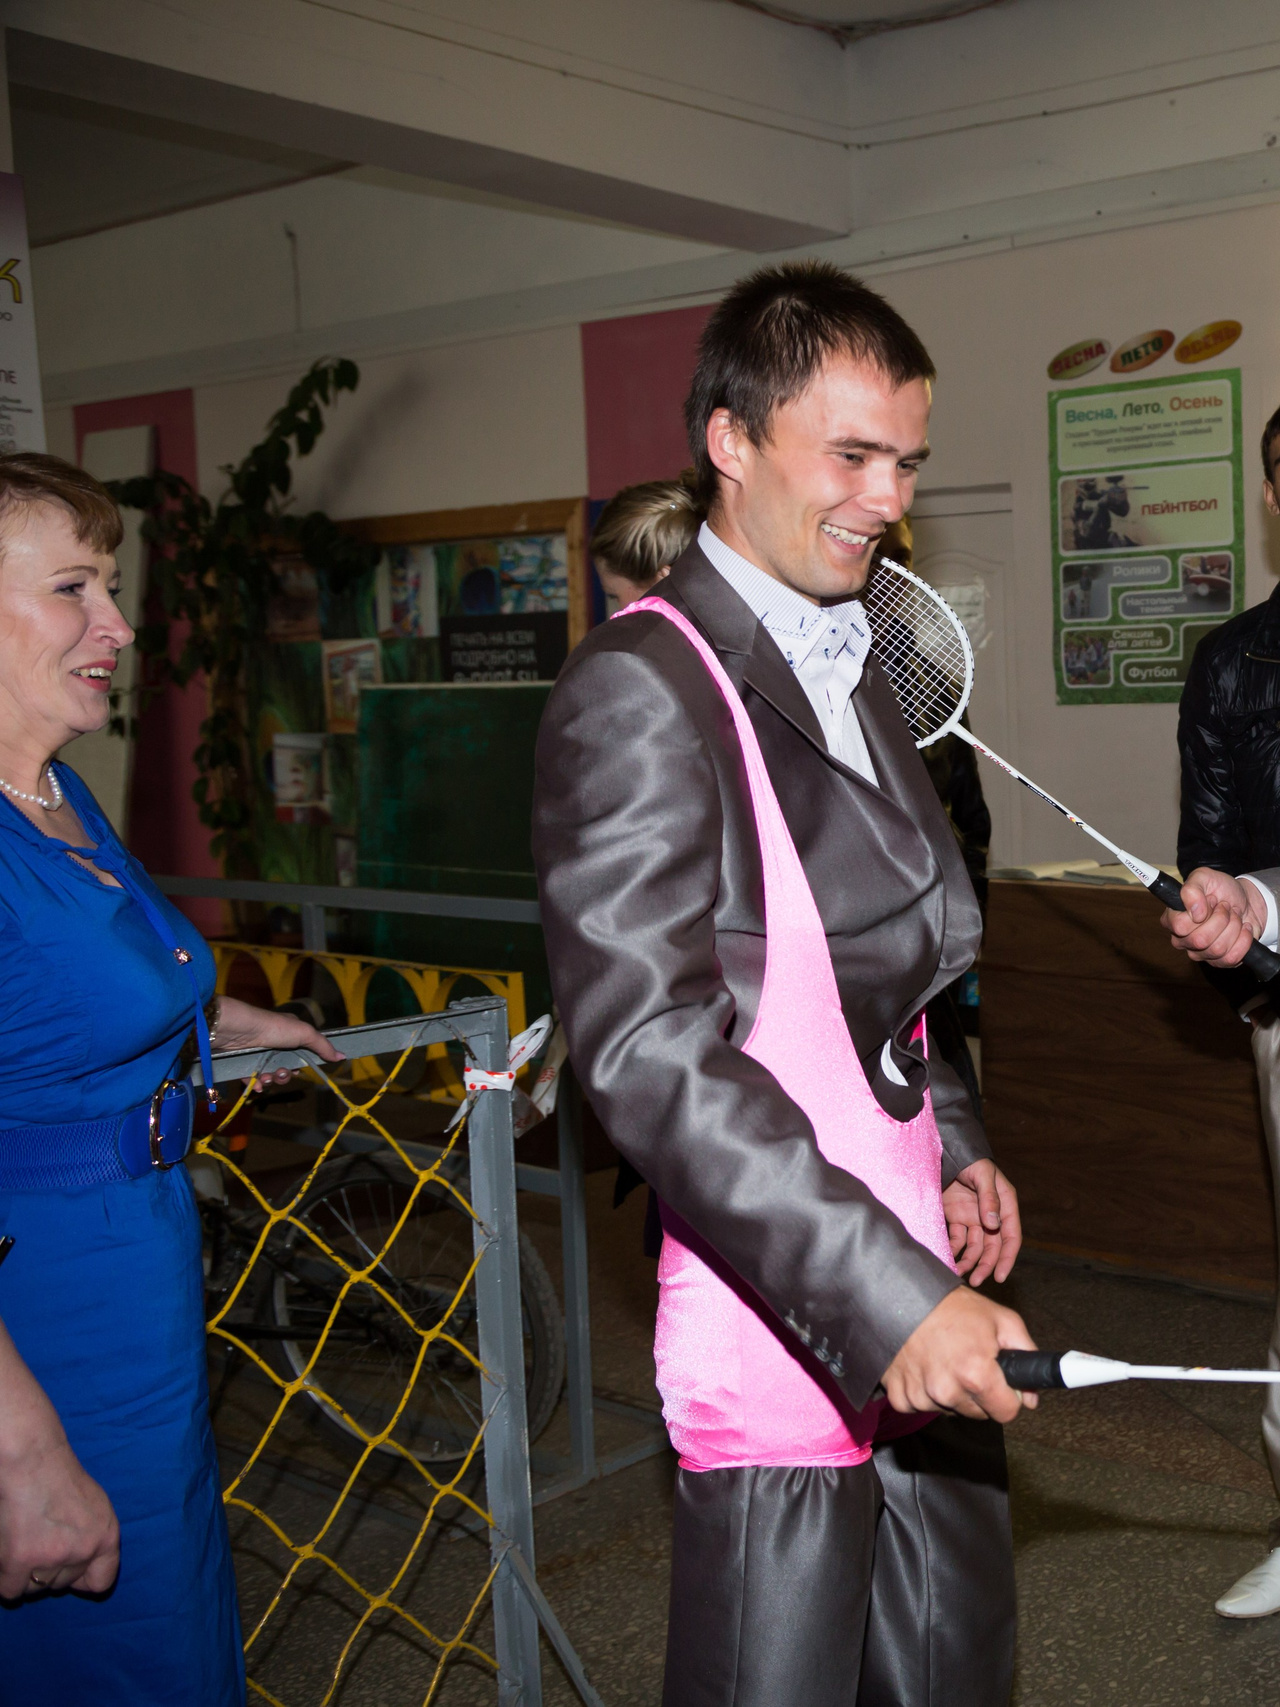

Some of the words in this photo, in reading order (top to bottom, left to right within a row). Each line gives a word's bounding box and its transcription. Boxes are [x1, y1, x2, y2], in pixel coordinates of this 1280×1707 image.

[1179, 327, 1237, 359] ОСЕНЬ
[1053, 342, 1107, 374] ВЕСНА
[1120, 336, 1164, 367] ЛЕТО
[1065, 407, 1117, 423] Весна,
[1122, 401, 1164, 417] Лето,
[1169, 396, 1223, 411] Осень
[1141, 498, 1218, 516] ПЕЙНТБОЛ
[1113, 565, 1161, 577] Ролики
[1126, 594, 1188, 606] Настольный
[1112, 630, 1154, 641] Секции
[1130, 636, 1163, 648] детей
[1128, 666, 1177, 680] Футбол
